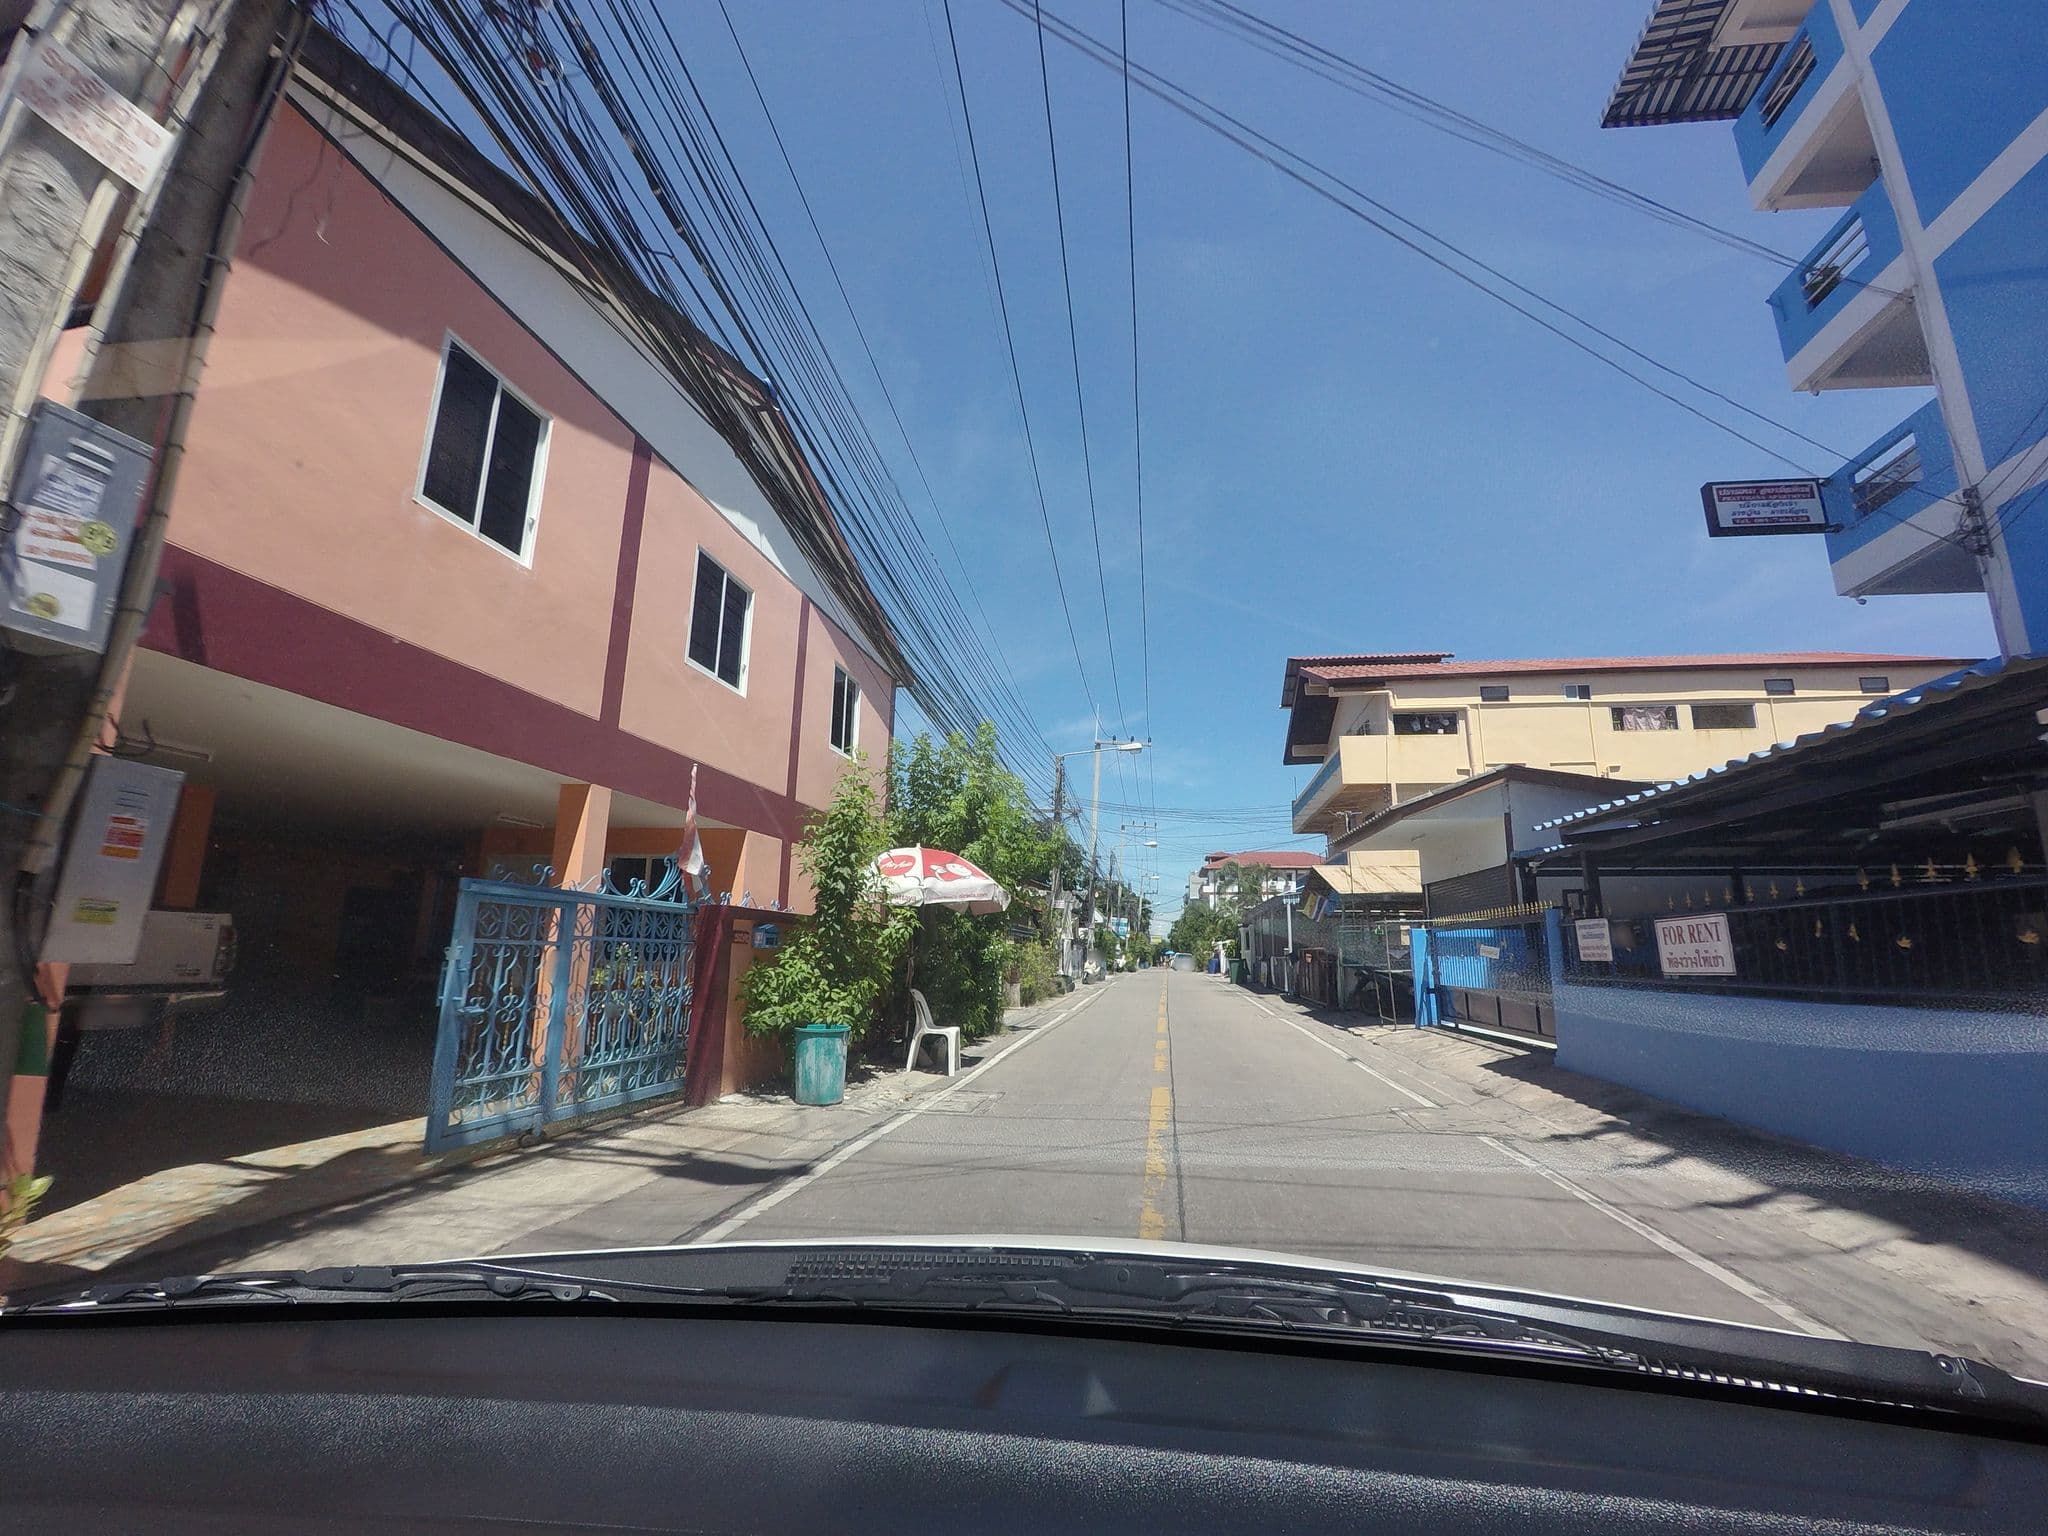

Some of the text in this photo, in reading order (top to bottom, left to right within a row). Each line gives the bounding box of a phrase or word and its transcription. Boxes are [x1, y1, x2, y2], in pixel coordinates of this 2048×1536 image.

[1662, 921, 1721, 946] FOR RENT
[1666, 949, 1726, 969] ห้องว่างให้เช่า
